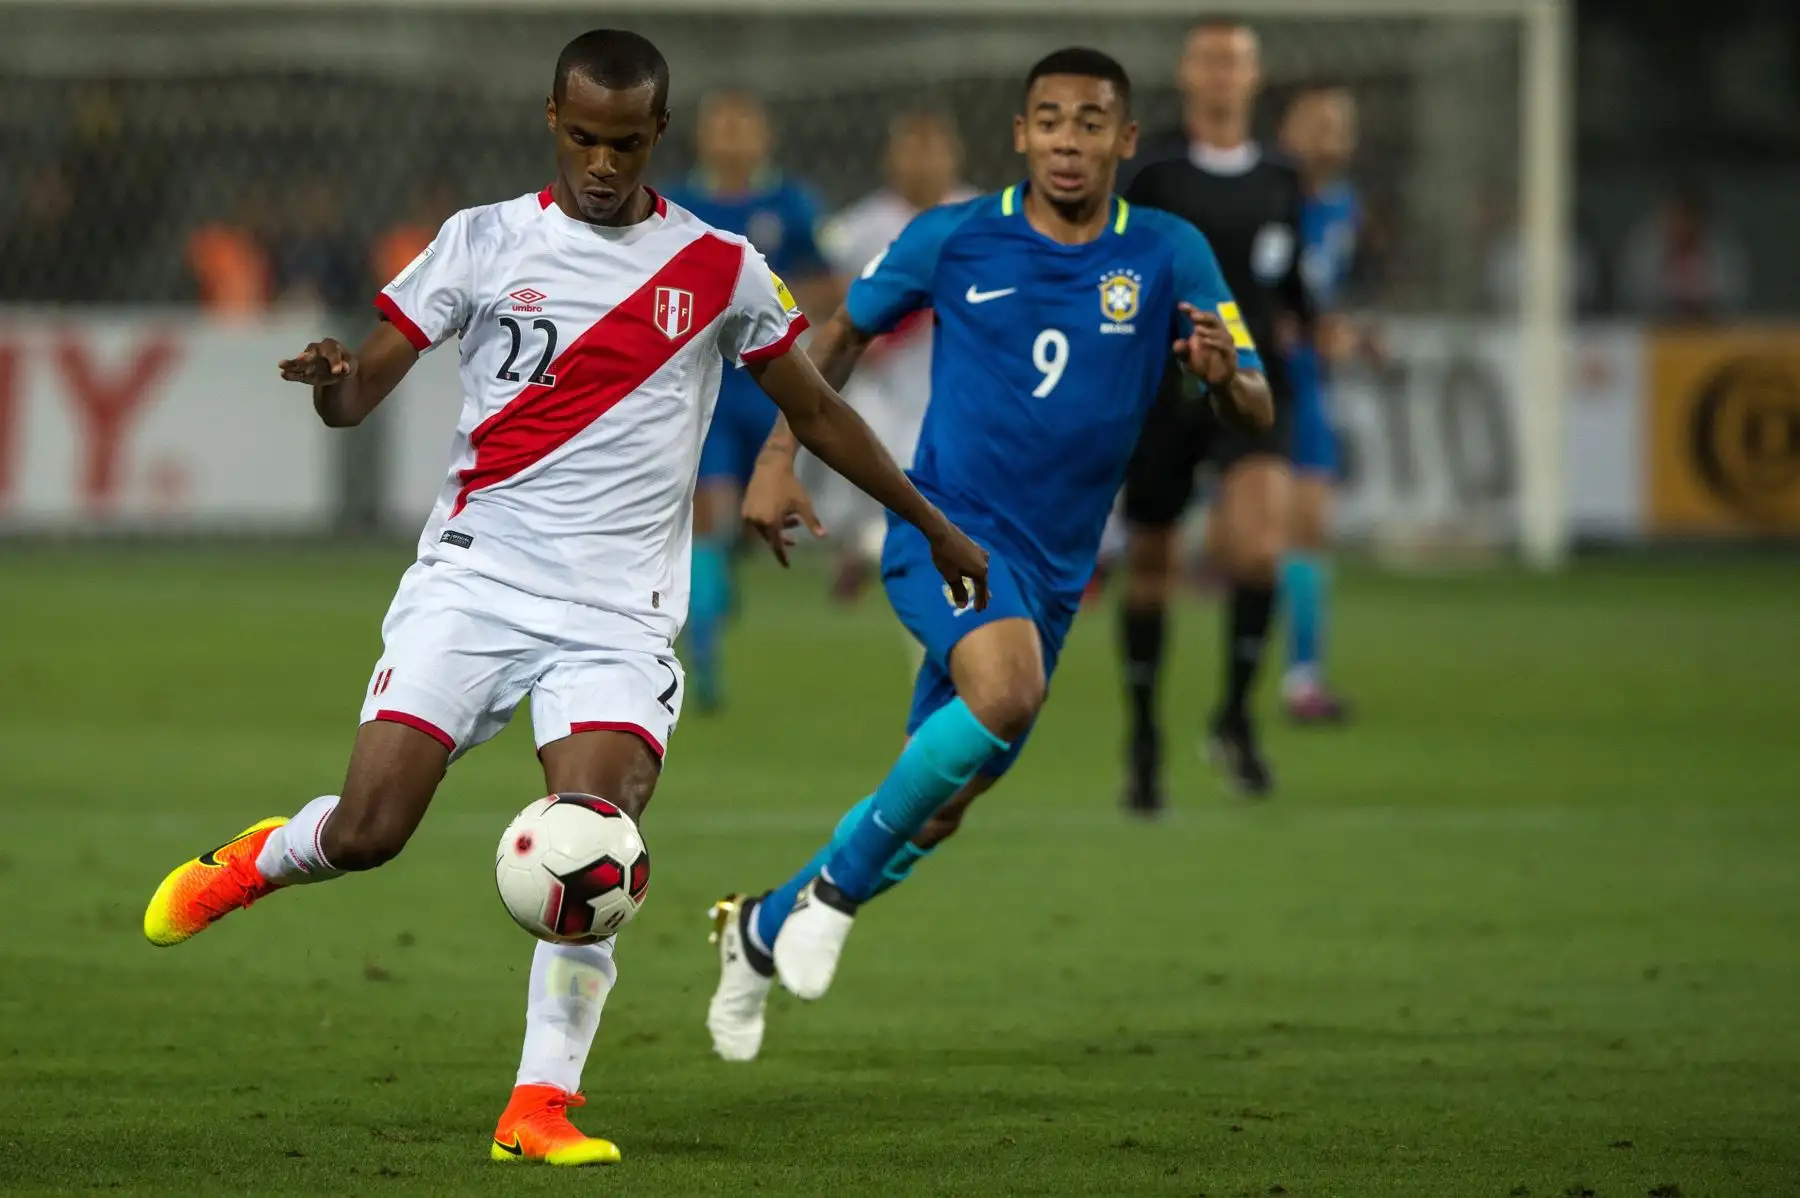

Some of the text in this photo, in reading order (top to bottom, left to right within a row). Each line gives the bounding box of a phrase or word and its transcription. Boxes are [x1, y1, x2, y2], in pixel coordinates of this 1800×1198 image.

[512, 304, 543, 313] umbro
[496, 317, 557, 387] 22
[1031, 328, 1070, 398] 9
